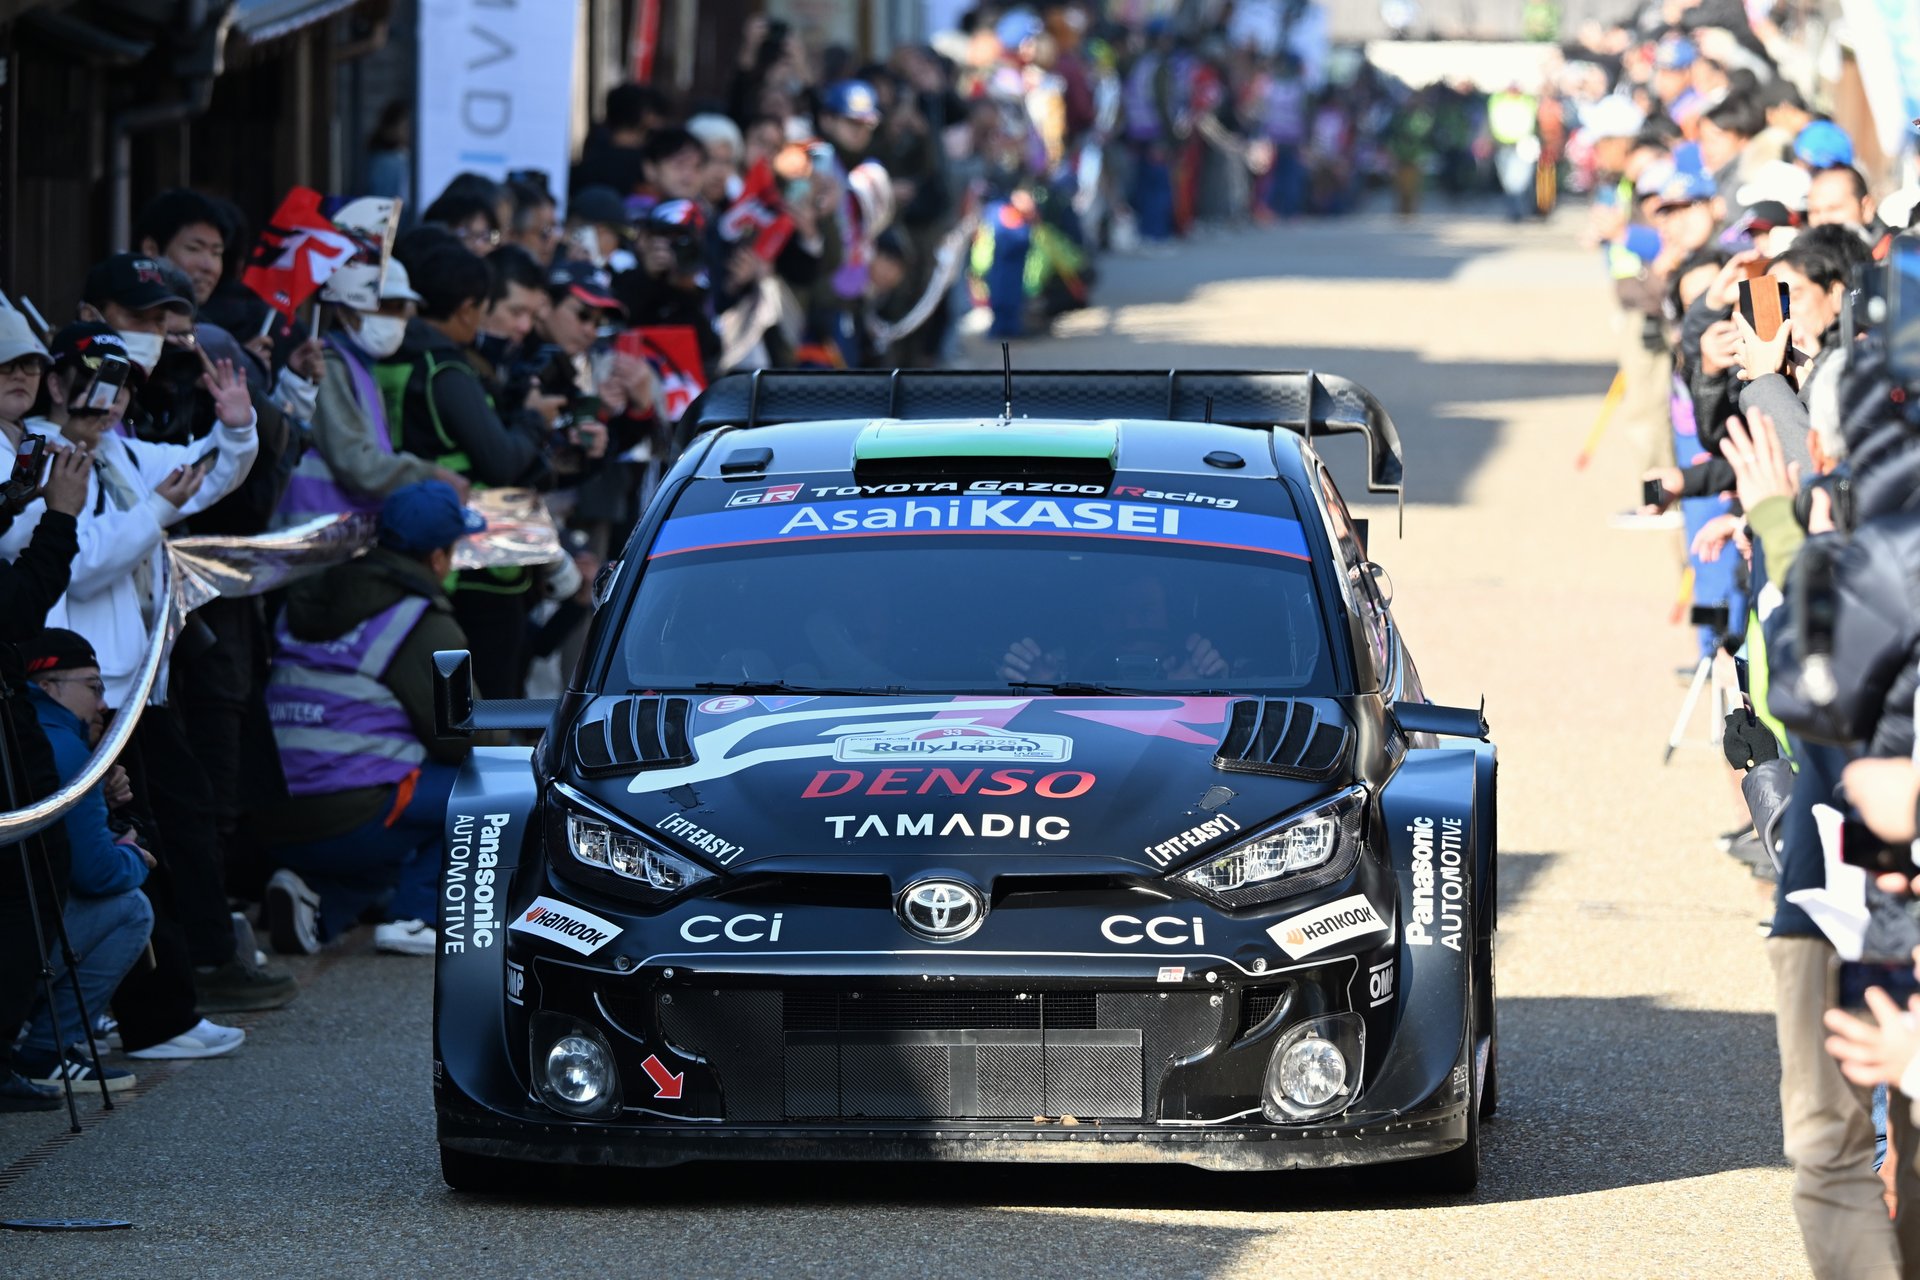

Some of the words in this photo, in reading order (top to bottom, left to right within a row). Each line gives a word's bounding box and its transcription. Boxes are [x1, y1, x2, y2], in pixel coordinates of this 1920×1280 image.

[731, 489, 798, 507] GR
[810, 482, 959, 498] TOYOTA
[968, 480, 1105, 495] GAZOO
[1113, 485, 1239, 509] Racing
[778, 499, 960, 535] Asahi
[970, 499, 1180, 535] KASEI
[942, 728, 962, 736] 33
[800, 768, 1096, 799] DENSO
[824, 813, 1071, 841] TAMADIC
[445, 814, 475, 955] AUTOMOTIVE
[472, 813, 511, 949] Panasonic
[1405, 816, 1434, 946] Panasonic
[1440, 817, 1463, 952] AUTOMOTIVE
[1369, 966, 1394, 999] OMP
